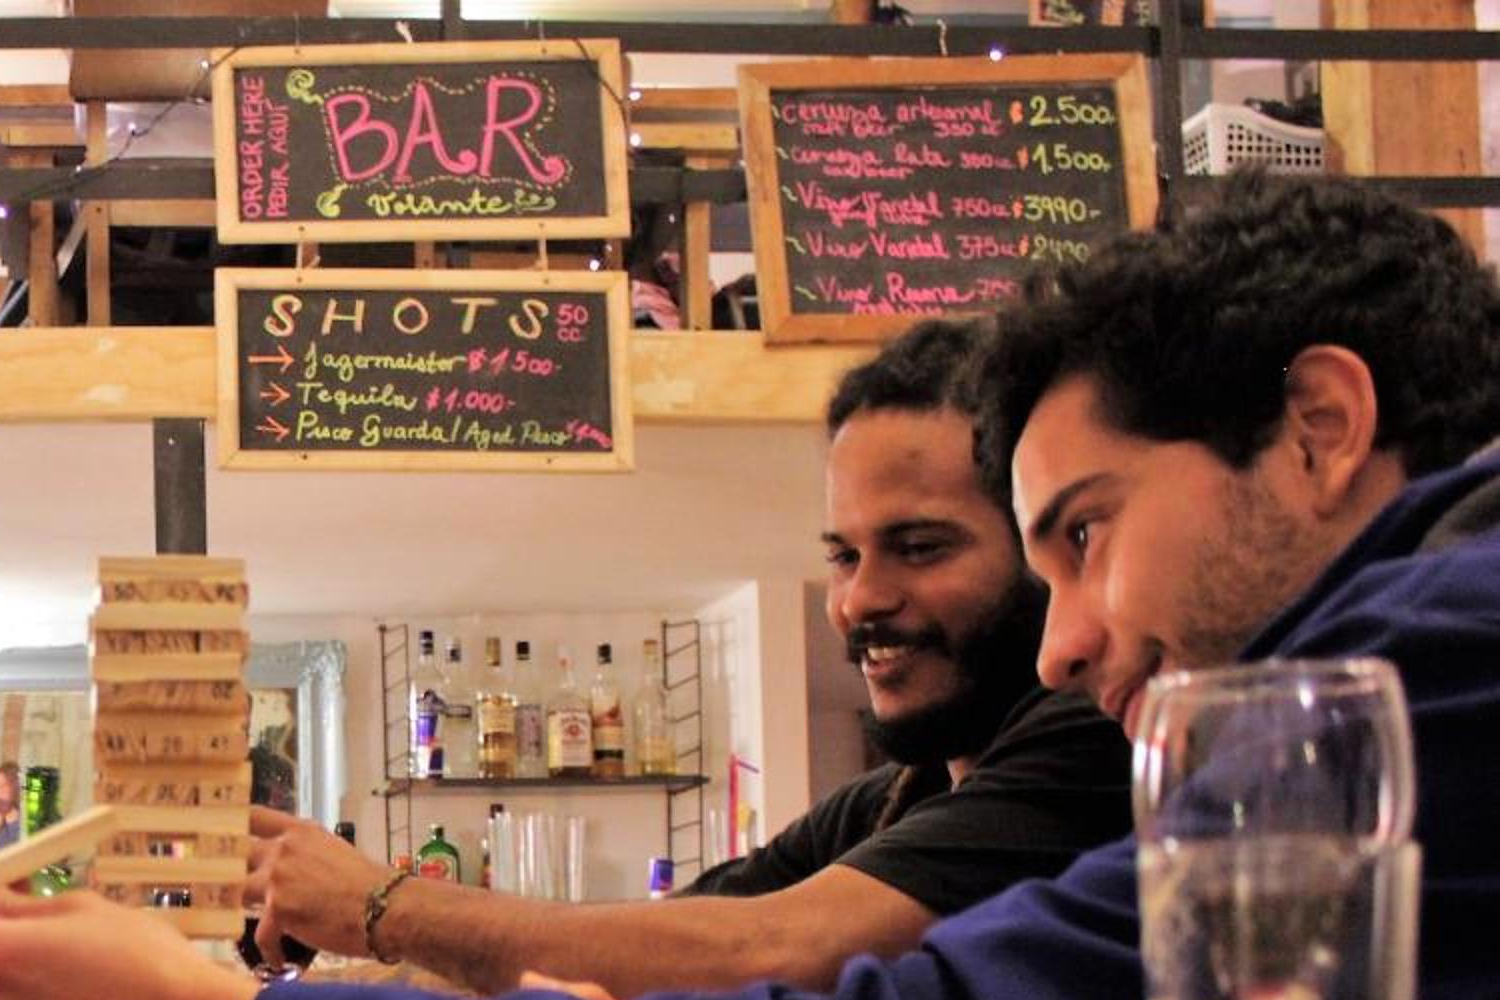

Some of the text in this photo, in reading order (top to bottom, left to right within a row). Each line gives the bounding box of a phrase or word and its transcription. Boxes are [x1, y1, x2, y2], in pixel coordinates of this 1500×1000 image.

[240, 76, 265, 218] ORDER HERE
[324, 76, 566, 184] BAR
[266, 161, 290, 217] PEDIR
[264, 294, 589, 341] SHOTS 50
[296, 382, 419, 415] Tequila
